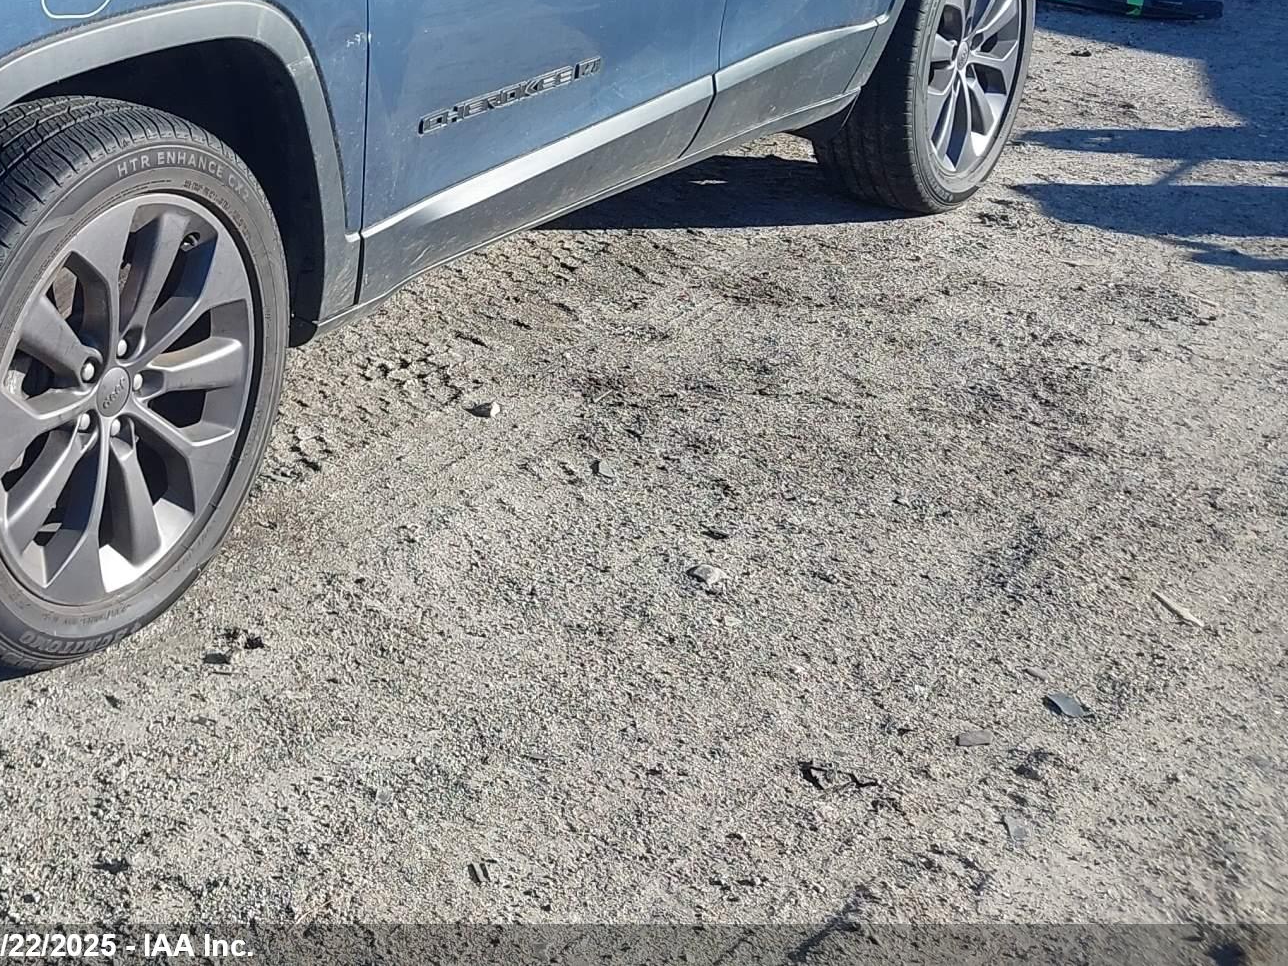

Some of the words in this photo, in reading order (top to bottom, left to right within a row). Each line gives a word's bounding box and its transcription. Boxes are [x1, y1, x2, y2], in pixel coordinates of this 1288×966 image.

[418, 64, 575, 135] CHEROKEE
[117, 154, 151, 178] HTR
[157, 151, 223, 177] ENHANCE
